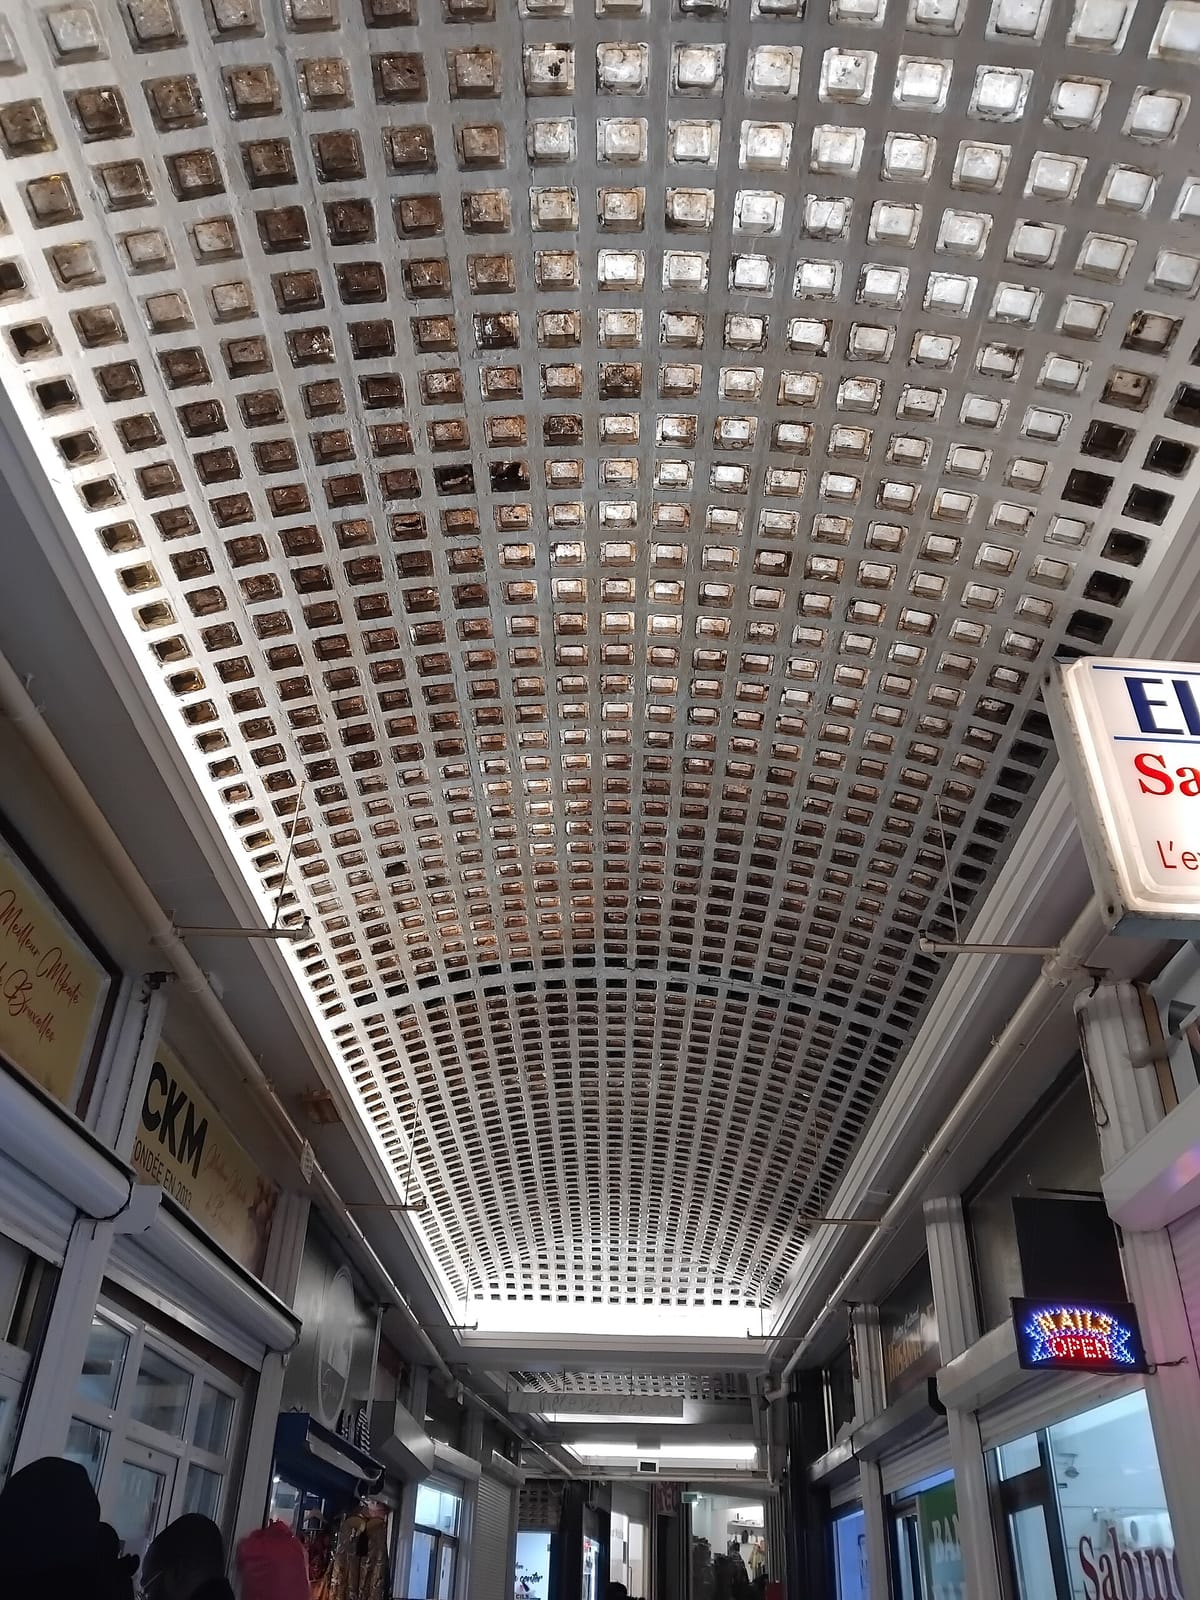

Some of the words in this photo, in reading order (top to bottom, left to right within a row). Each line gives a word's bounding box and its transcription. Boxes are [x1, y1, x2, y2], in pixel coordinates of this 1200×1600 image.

[1156, 840, 1200, 871] L'e
[142, 1061, 208, 1179] CKM
[133, 1136, 164, 1187] ONDÉE
[164, 1168, 177, 1196] EN
[176, 1182, 192, 1210] 2013
[1038, 1310, 1112, 1336] NAILS
[1051, 1337, 1112, 1359] OPEN
[520, 1572, 543, 1584] center
[1079, 1526, 1185, 1600] Sabin
